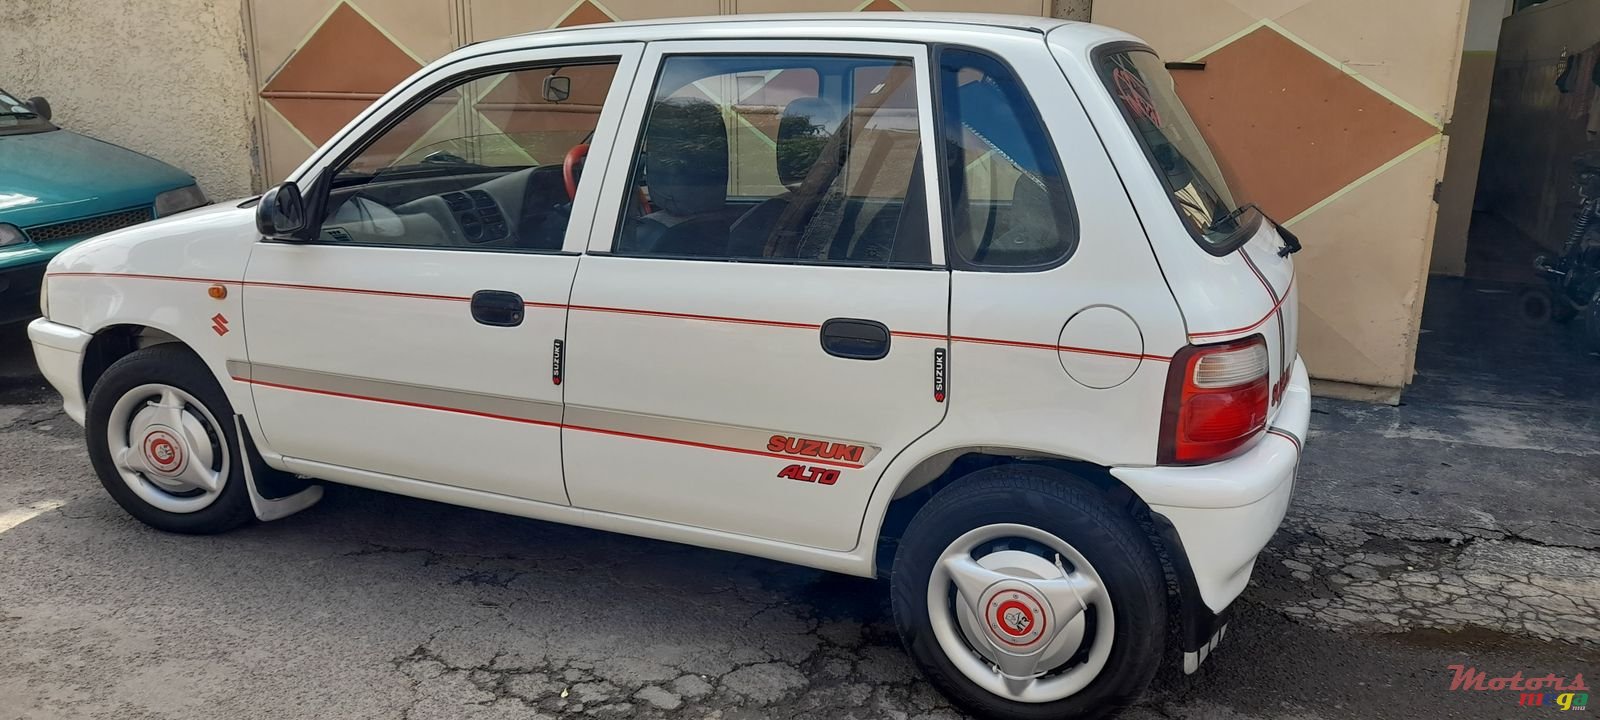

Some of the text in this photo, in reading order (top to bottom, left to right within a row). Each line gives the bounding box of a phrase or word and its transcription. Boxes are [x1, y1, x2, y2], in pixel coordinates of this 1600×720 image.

[553, 342, 561, 376] SUZUKI
[935, 351, 943, 391] SUZUKI
[767, 435, 864, 462] SUZUKI
[777, 464, 841, 485] ALTO
